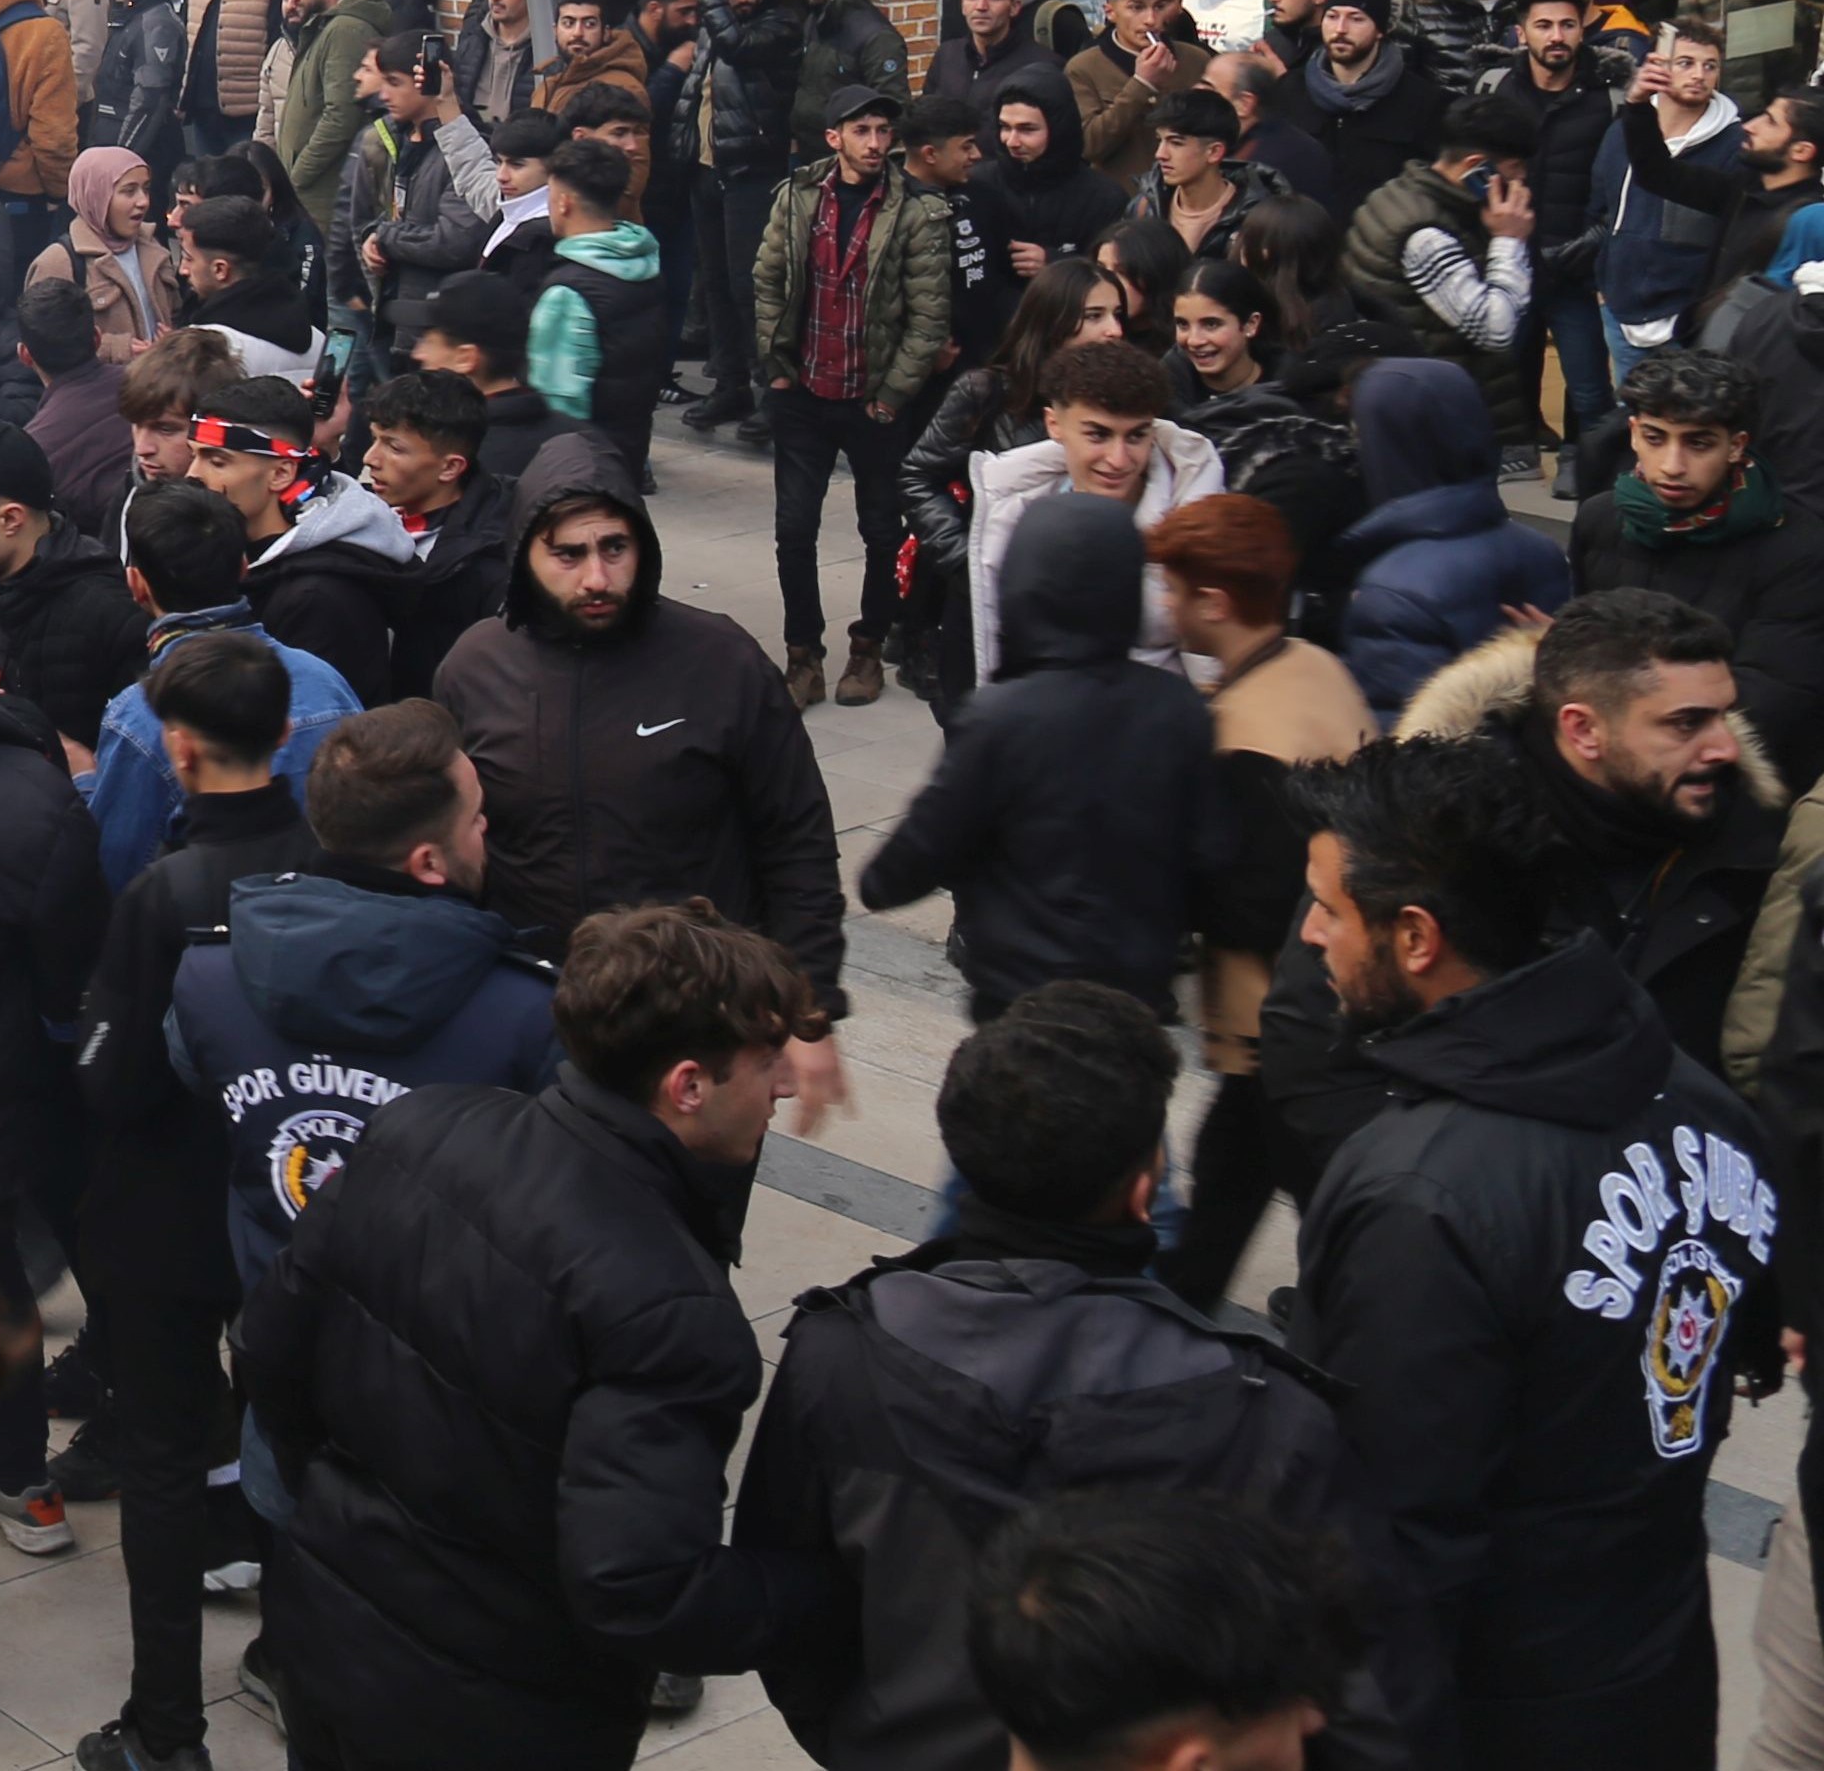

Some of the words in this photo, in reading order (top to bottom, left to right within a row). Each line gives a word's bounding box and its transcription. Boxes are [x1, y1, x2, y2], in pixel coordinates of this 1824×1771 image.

[222, 1066, 286, 1124] SPOR
[1563, 1142, 1680, 1320] SPOR
[1672, 1124, 1779, 1265] ŞUBE
